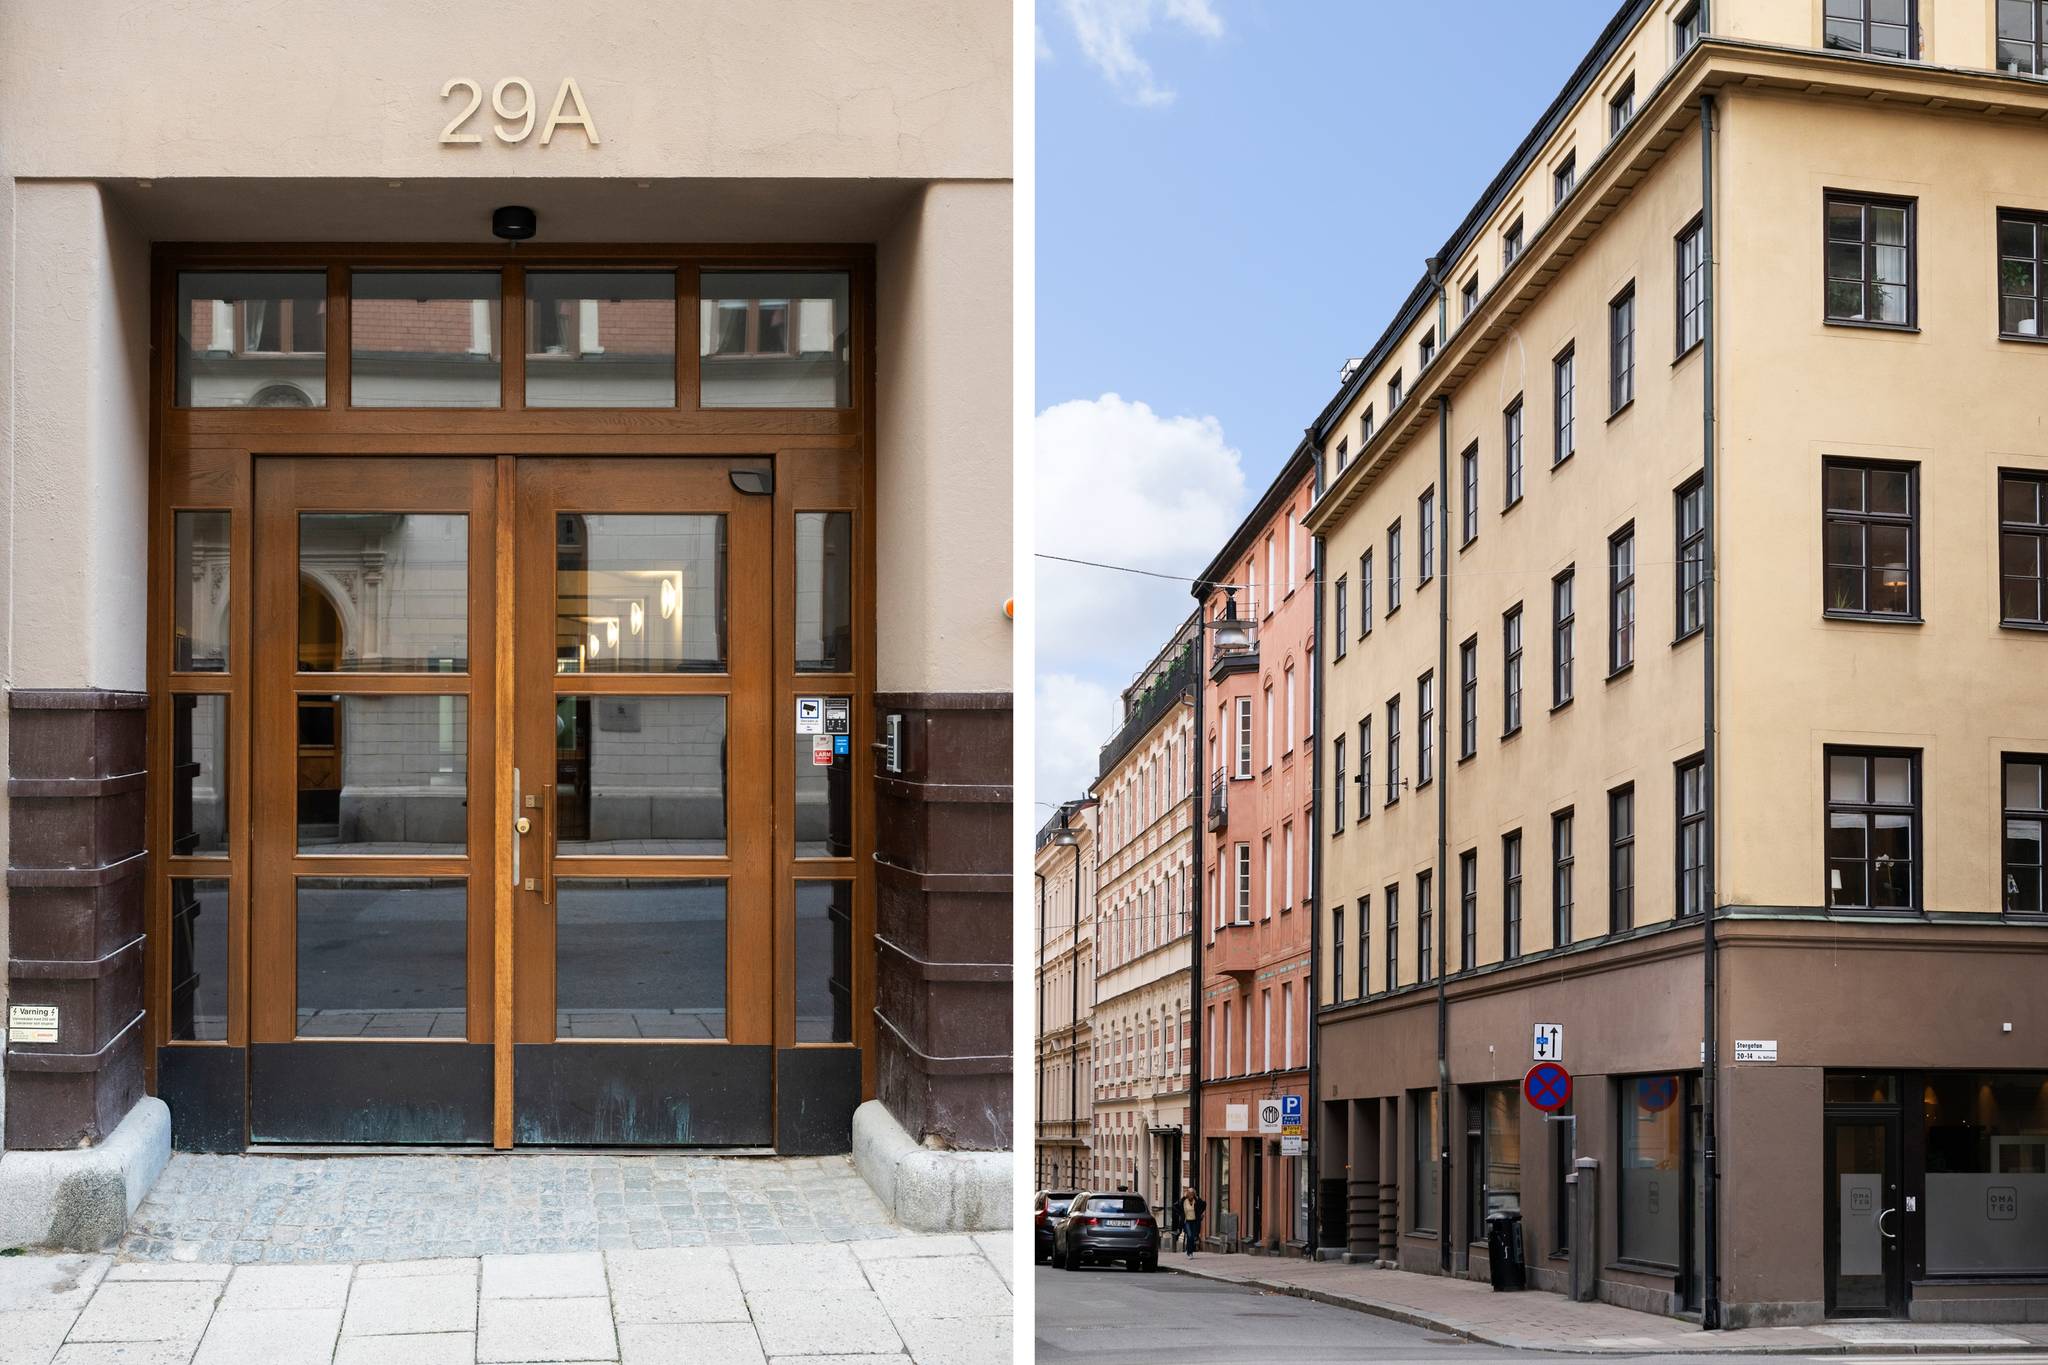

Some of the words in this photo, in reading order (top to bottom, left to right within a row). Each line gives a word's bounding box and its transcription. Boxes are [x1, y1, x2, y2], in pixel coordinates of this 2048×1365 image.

[438, 76, 601, 145] 29A
[20, 1008, 49, 1017] Varning
[1736, 1042, 1763, 1050] Storgatan
[1736, 1052, 1753, 1060] 20-14
[1286, 1097, 1298, 1114] P
[1990, 1194, 2014, 1203] OMA
[1991, 1203, 2014, 1212] TEQ
